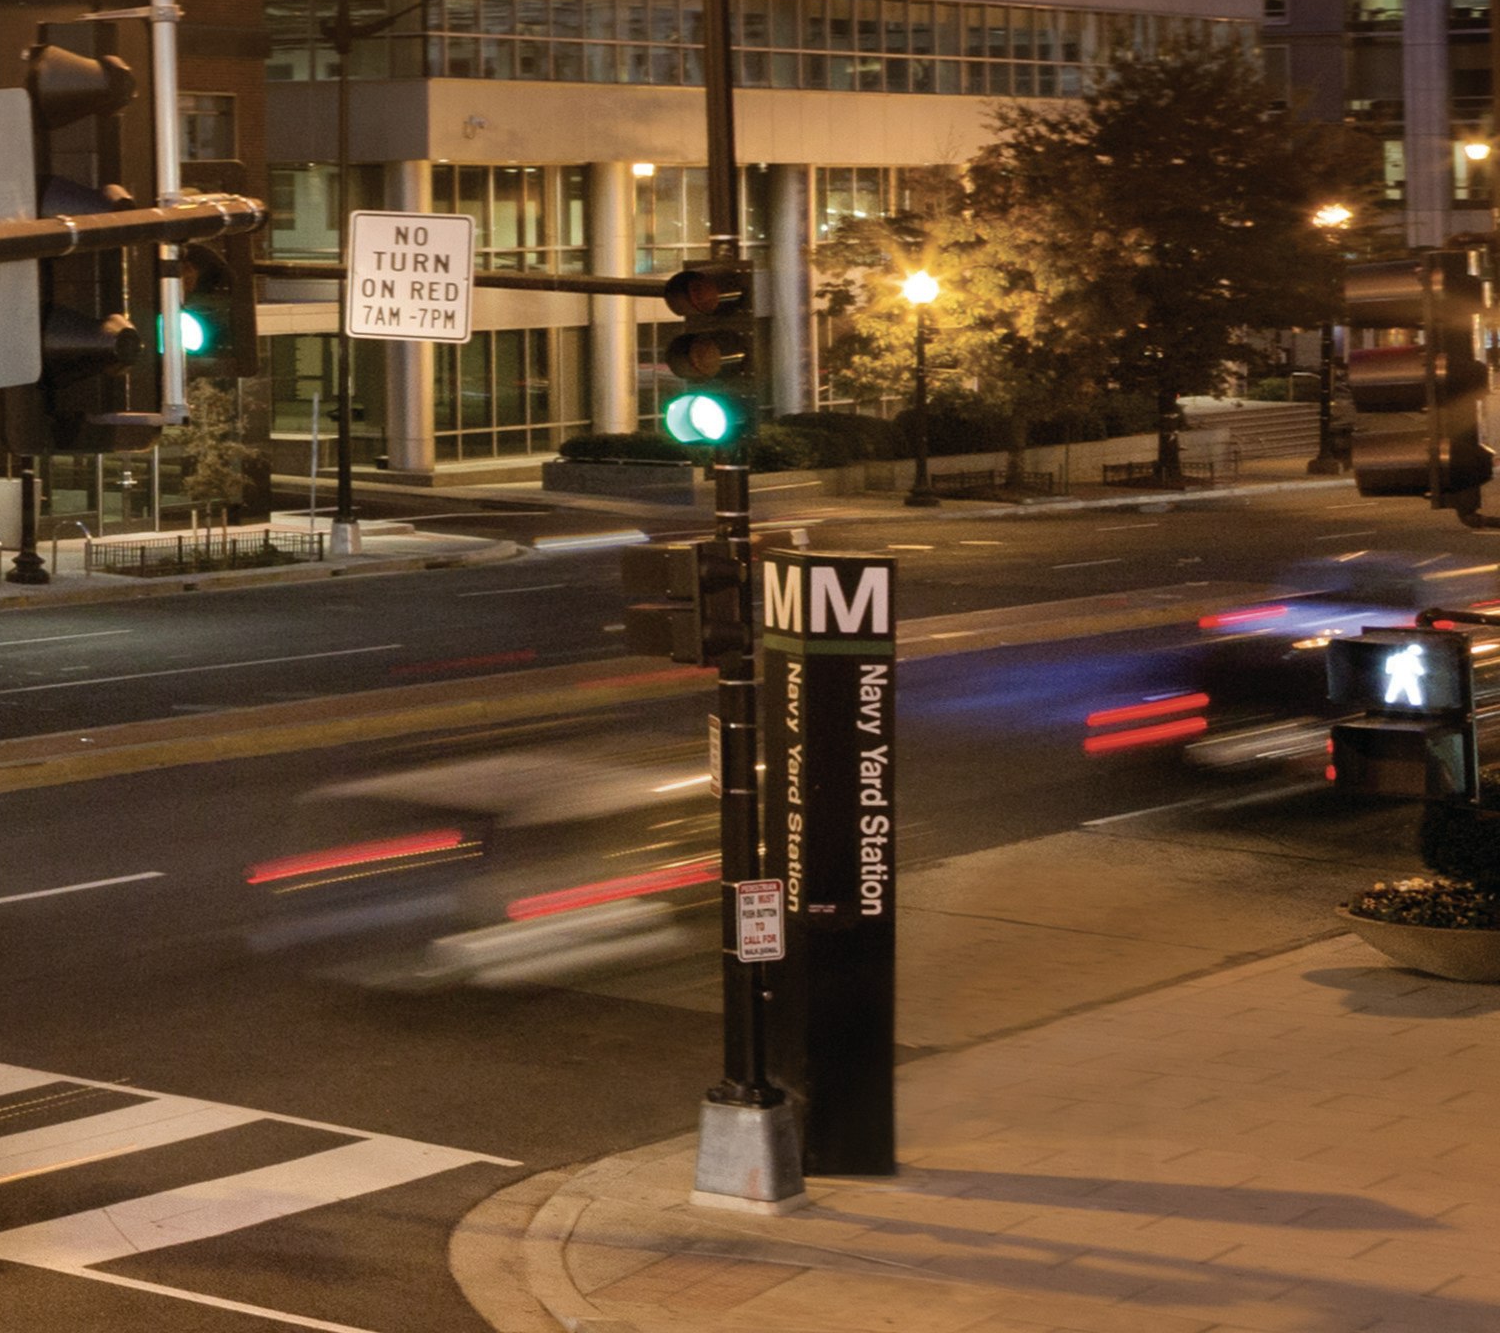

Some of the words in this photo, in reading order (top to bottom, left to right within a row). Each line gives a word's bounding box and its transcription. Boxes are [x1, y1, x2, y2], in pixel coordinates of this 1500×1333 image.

[373, 251, 450, 274] TURN
[394, 226, 428, 246] NO
[362, 278, 395, 298] ON
[410, 281, 459, 302] RED
[363, 305, 400, 326] 7AM
[764, 560, 803, 632] M
[809, 565, 890, 634] M
[786, 663, 802, 733] Navy
[856, 664, 888, 735] Navy
[787, 744, 803, 805] Yard
[860, 745, 888, 807] Yard
[787, 812, 803, 913] Station
[860, 814, 890, 916] Station
[744, 935, 761, 945] CALL
[762, 934, 777, 943] FOR
[755, 922, 765, 931] TO
